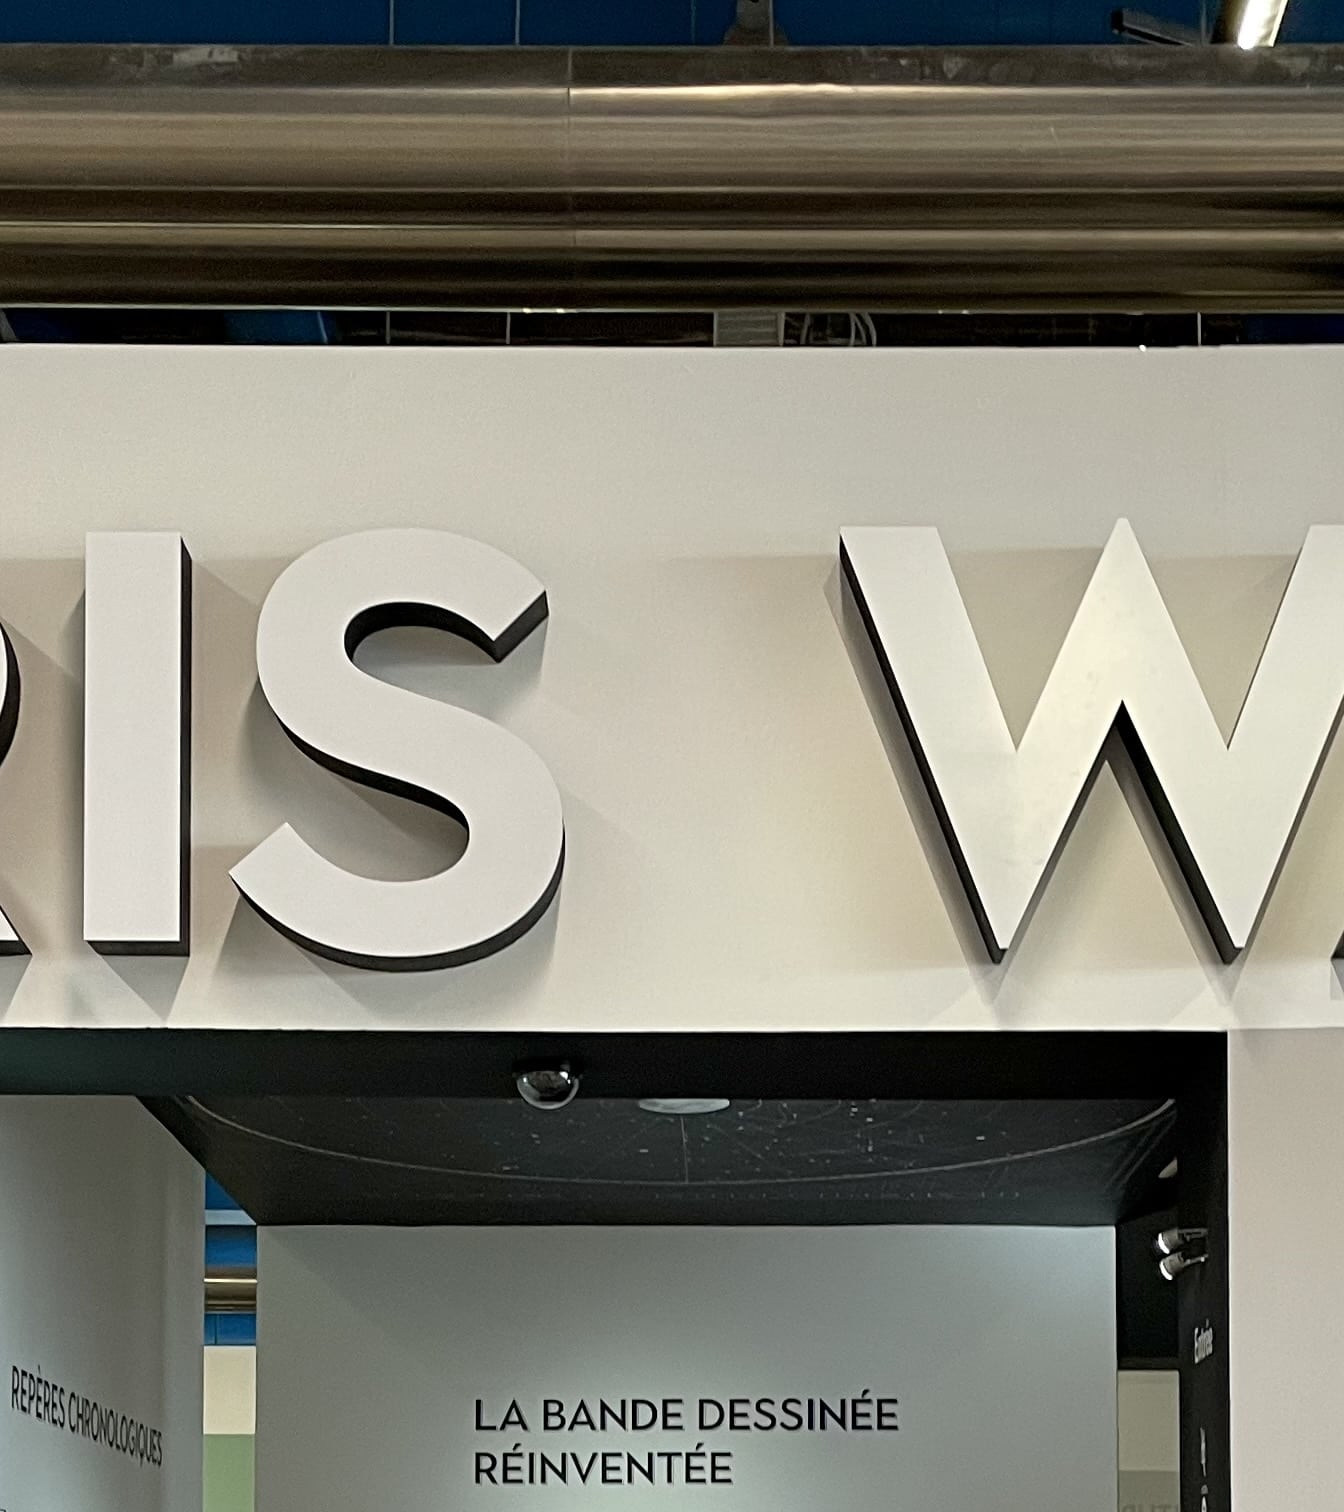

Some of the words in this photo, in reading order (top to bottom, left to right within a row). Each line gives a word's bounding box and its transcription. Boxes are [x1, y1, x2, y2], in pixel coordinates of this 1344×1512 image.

[11, 1364, 66, 1429] REPÈRES
[68, 1391, 163, 1468] CHRONOLOGIQUES
[474, 1398, 530, 1431] LA
[542, 1398, 685, 1431] BANDE
[698, 1388, 900, 1431] DESSINÉE
[474, 1442, 734, 1486] RÉINVENTÉE
